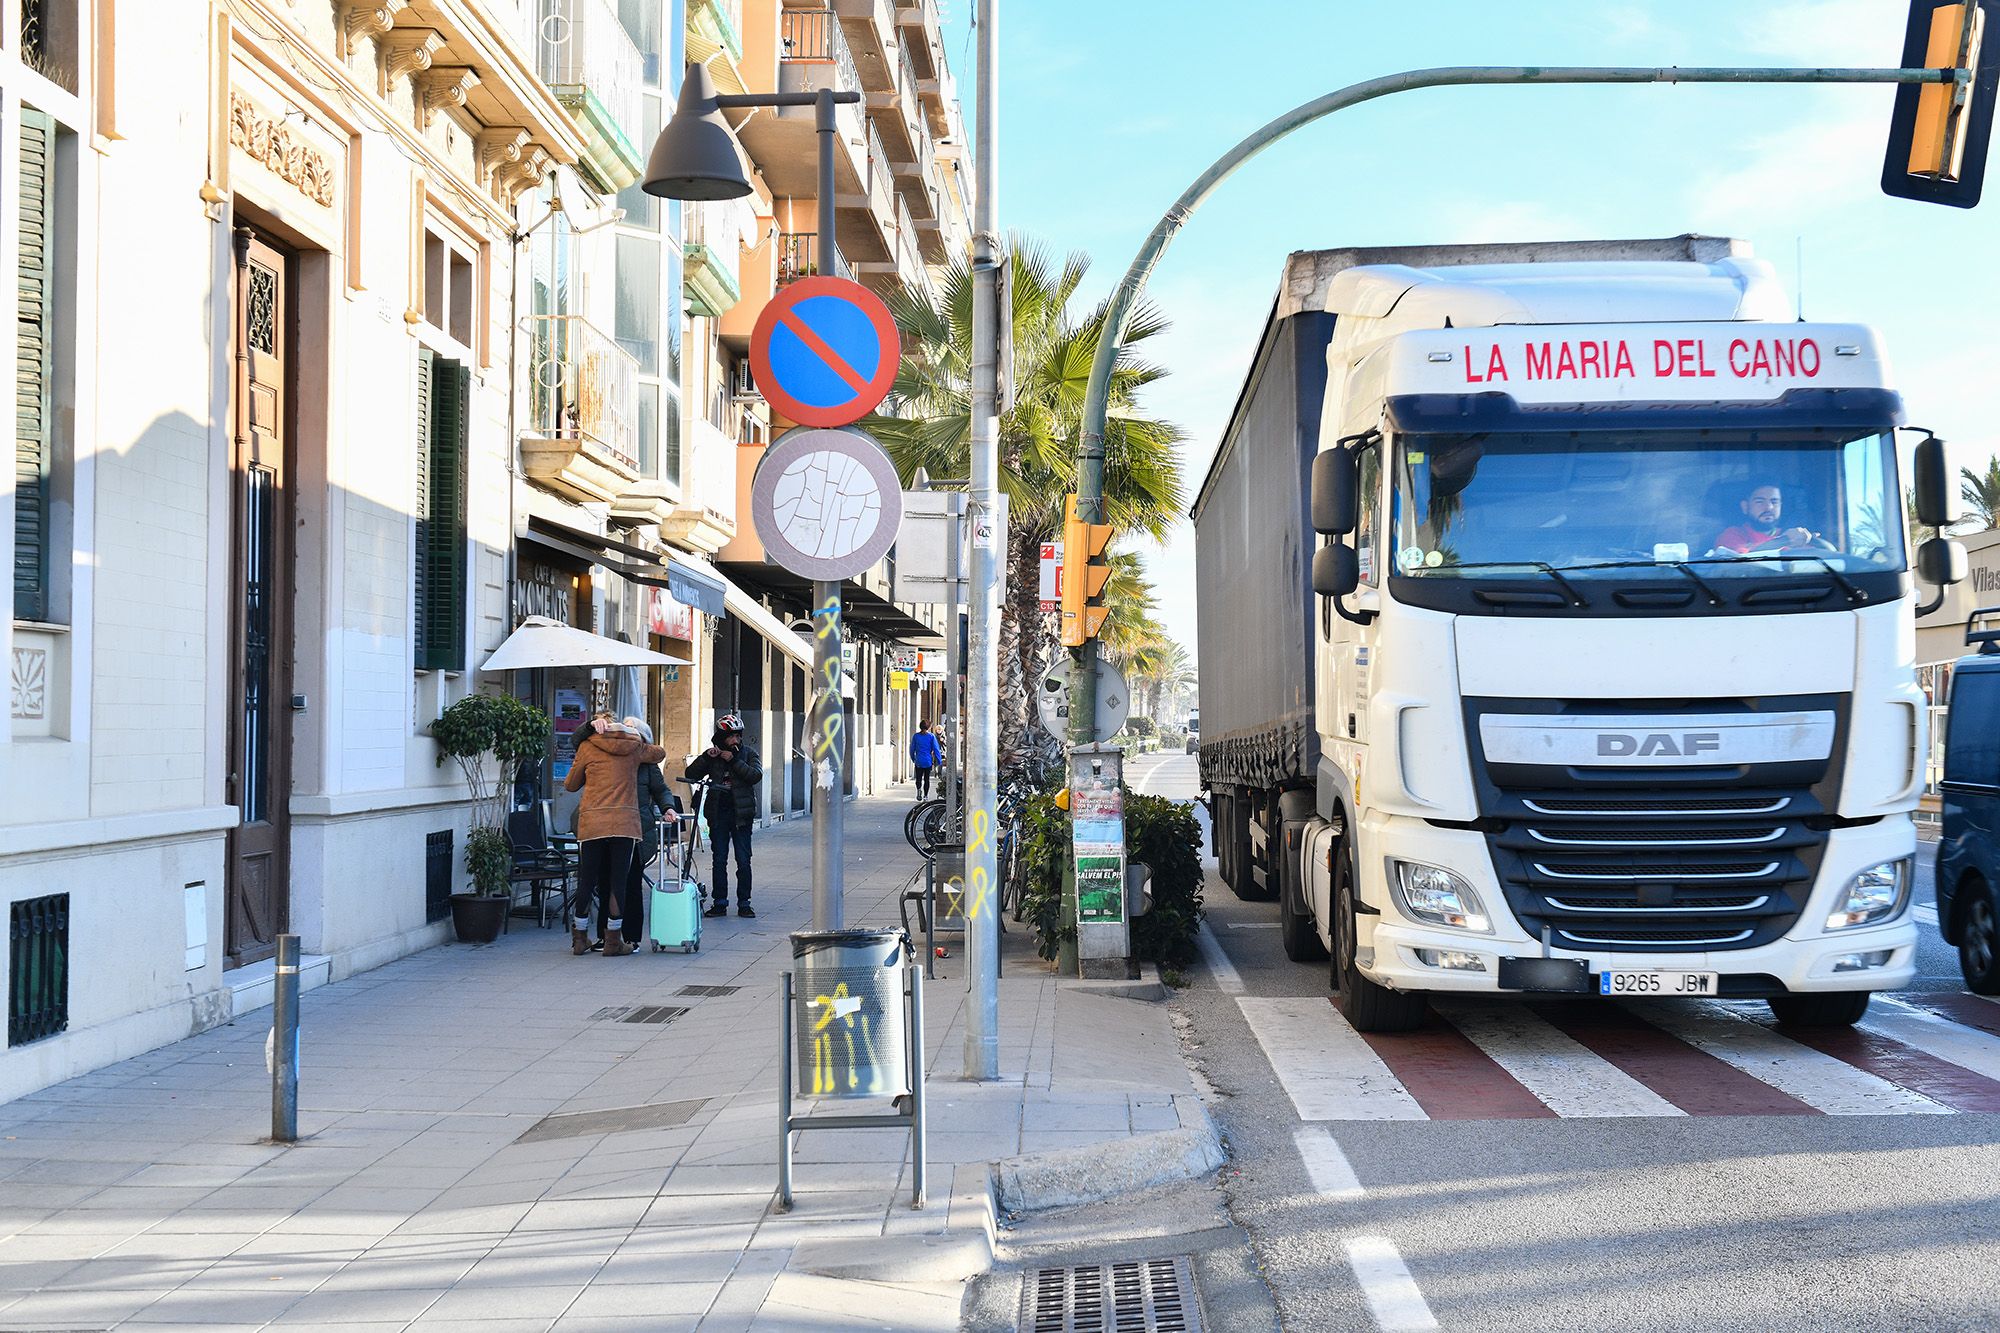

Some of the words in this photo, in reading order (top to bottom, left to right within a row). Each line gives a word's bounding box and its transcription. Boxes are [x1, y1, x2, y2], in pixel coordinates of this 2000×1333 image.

[1464, 344, 1508, 382] LA
[1525, 340, 1635, 380] MARIA
[1652, 339, 1714, 378] DEL
[1728, 337, 1820, 378] CANO
[517, 578, 568, 624] MOMENTS
[1597, 733, 1719, 756] DAF
[1077, 871, 1103, 879] SALVEM
[1103, 871, 1111, 879] EL
[1614, 974, 1659, 992] 9265
